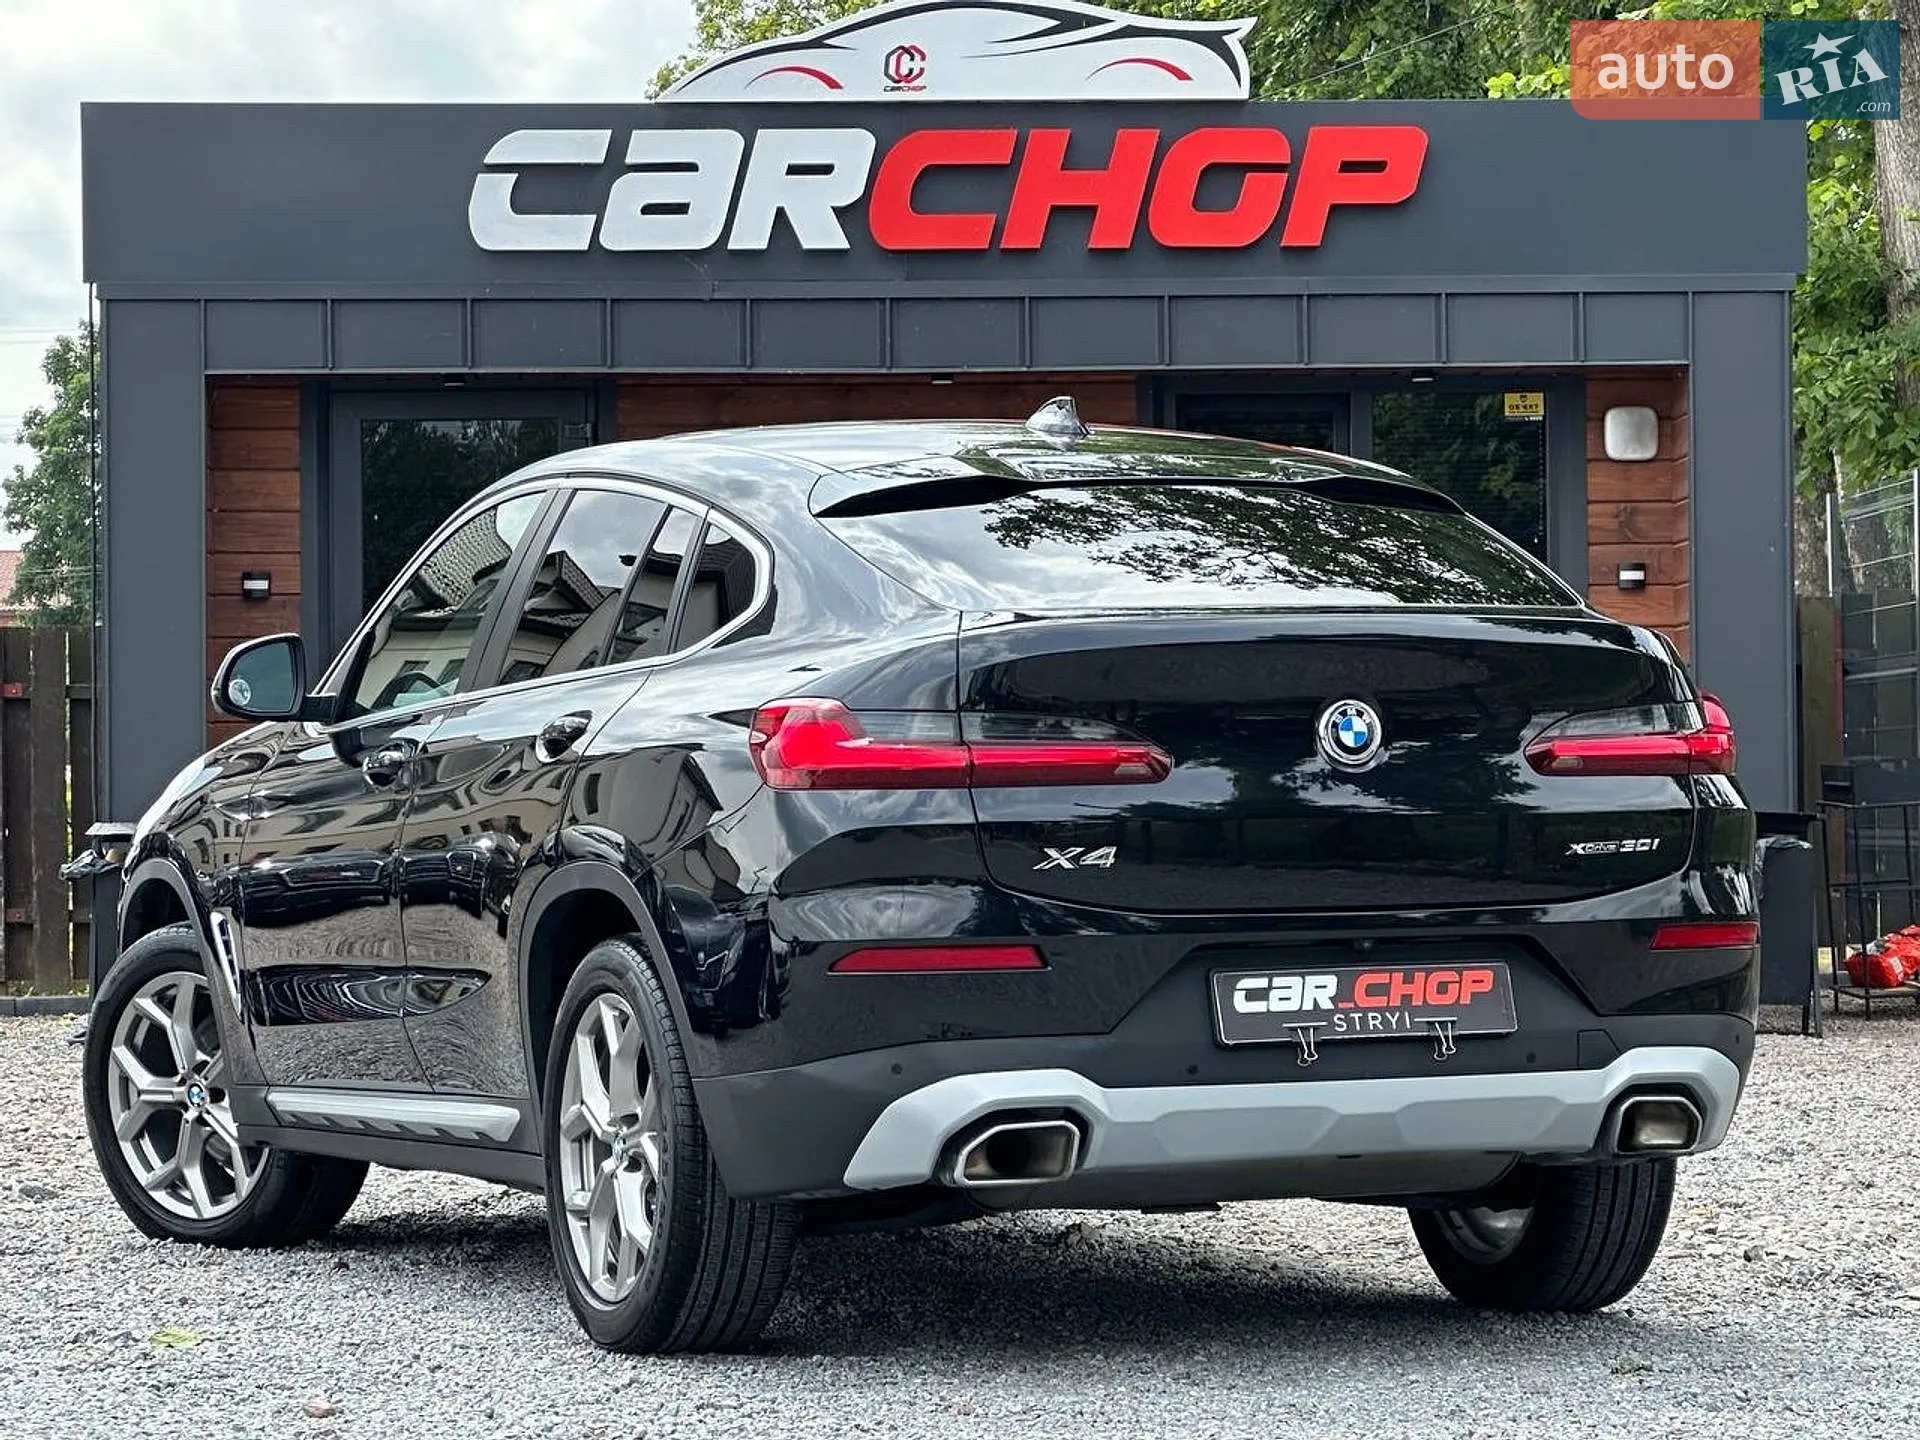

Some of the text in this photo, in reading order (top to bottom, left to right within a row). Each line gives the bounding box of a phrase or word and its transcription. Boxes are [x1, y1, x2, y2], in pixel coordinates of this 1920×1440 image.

[1332, 707, 1372, 724] BMW
[1032, 846, 1117, 869] X4
[1333, 1011, 1411, 1032] STRYI
